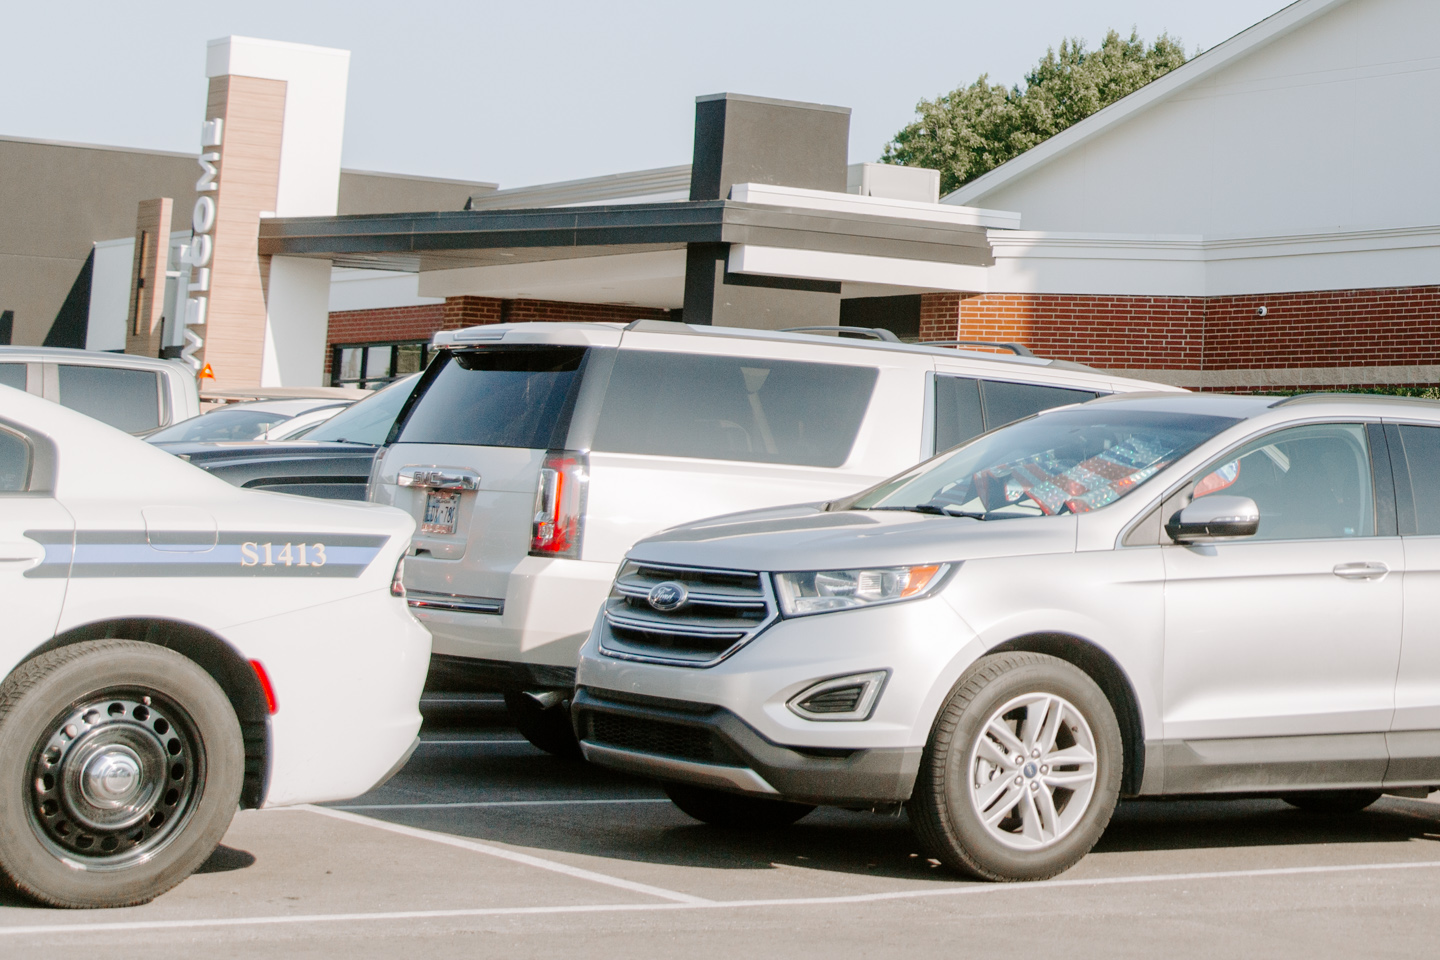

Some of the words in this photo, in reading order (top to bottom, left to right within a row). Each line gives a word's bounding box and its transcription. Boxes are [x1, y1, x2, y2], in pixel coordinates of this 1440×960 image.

[181, 118, 223, 370] WELCOME
[240, 541, 327, 567] S1413
[654, 586, 676, 602] Ford
